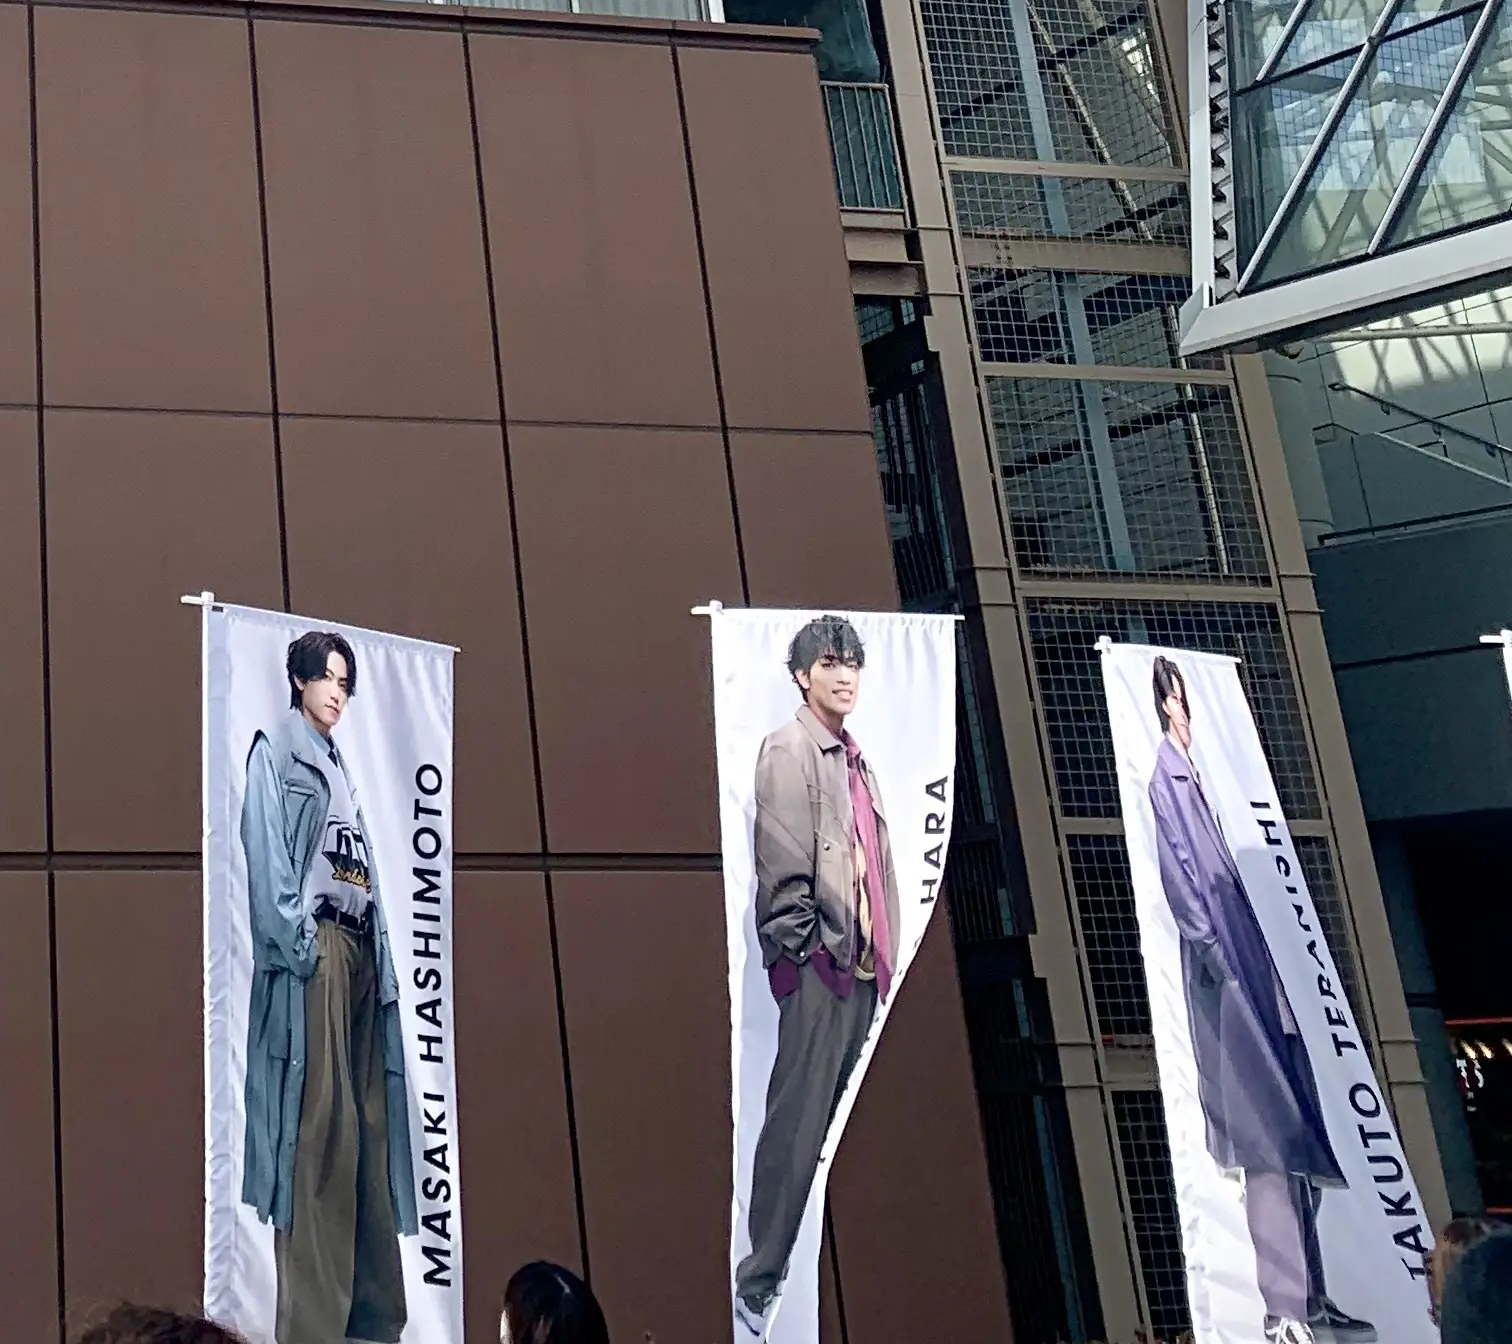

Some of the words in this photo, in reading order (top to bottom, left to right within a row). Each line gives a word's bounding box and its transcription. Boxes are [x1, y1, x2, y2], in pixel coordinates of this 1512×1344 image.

[411, 761, 444, 1065] HASHIMOTO
[919, 774, 949, 905] HARA
[421, 1091, 453, 1288] MASAKI
[1347, 1081, 1429, 1281] TAKUTO
